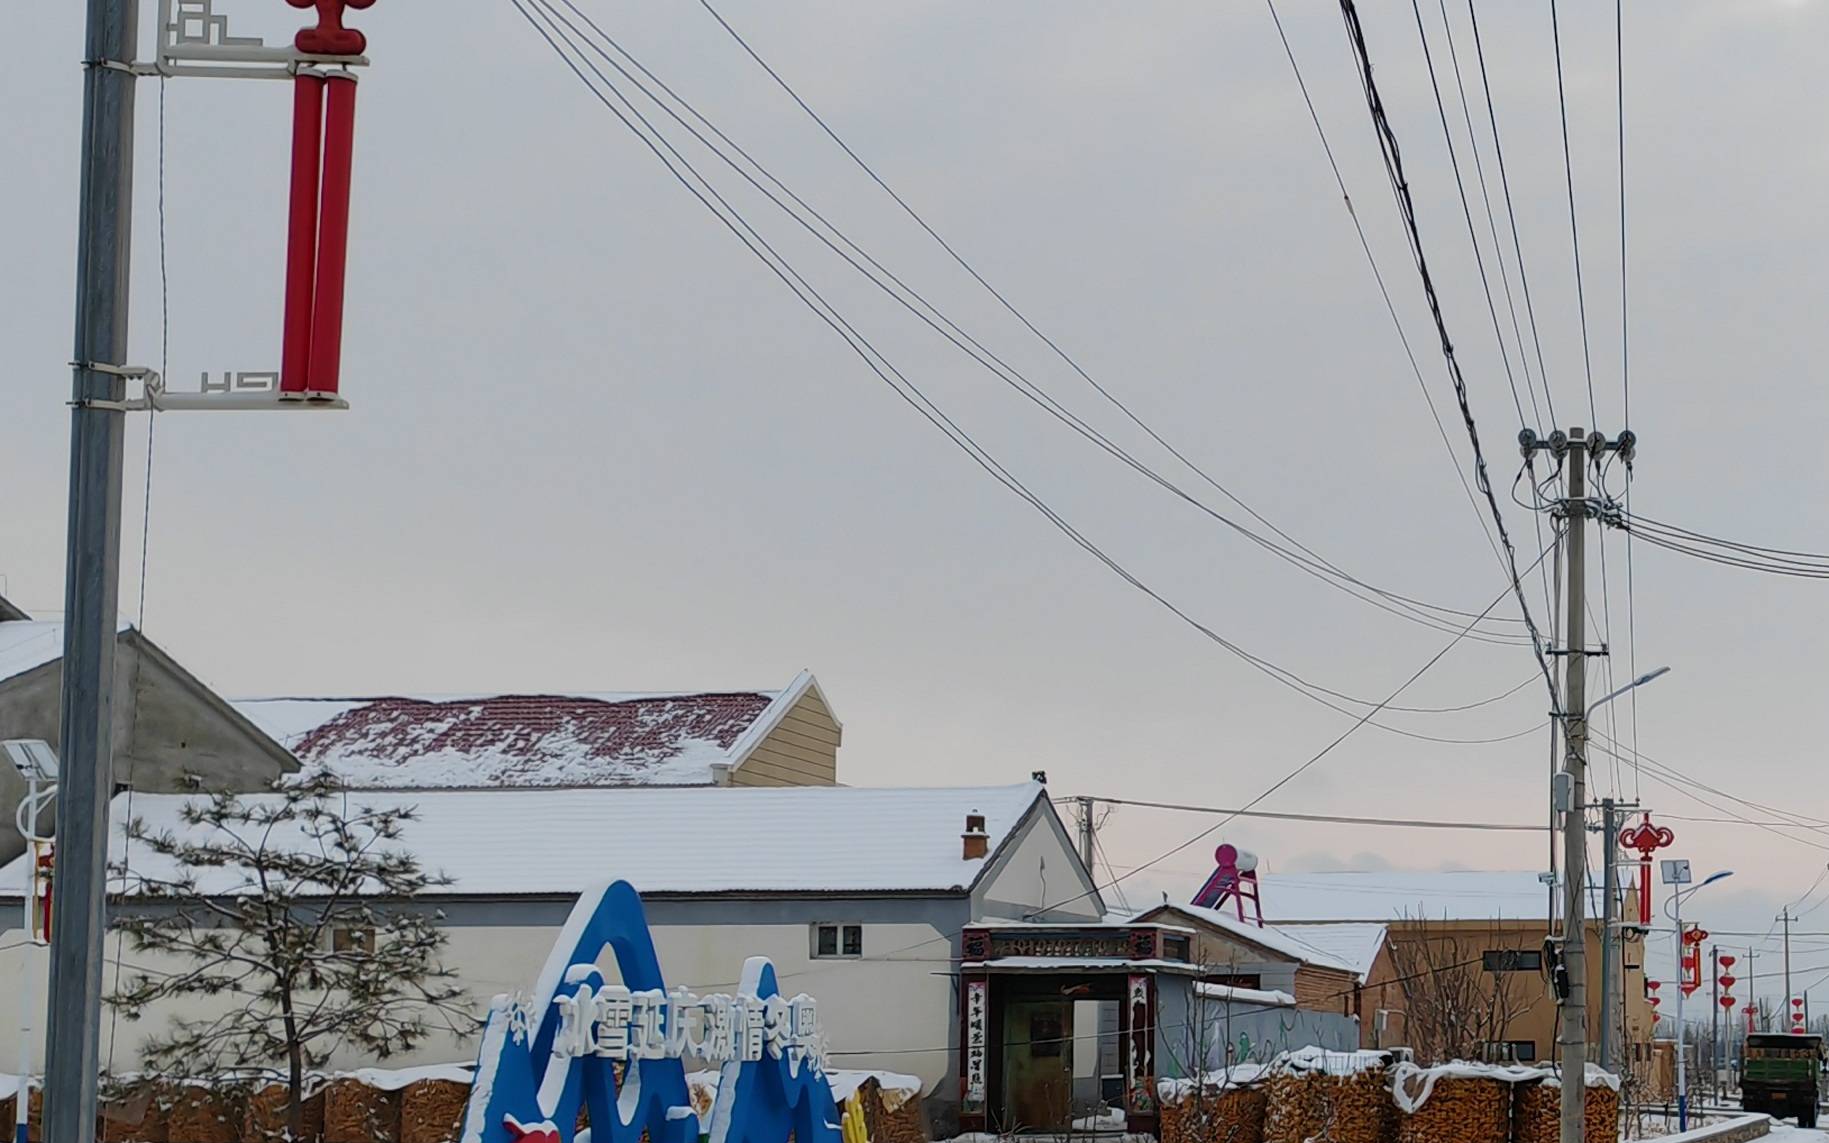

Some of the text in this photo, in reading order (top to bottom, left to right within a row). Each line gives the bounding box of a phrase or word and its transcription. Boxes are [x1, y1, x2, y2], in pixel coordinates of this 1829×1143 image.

[553, 985, 820, 1061] 冰雪延庆激情冬奥
